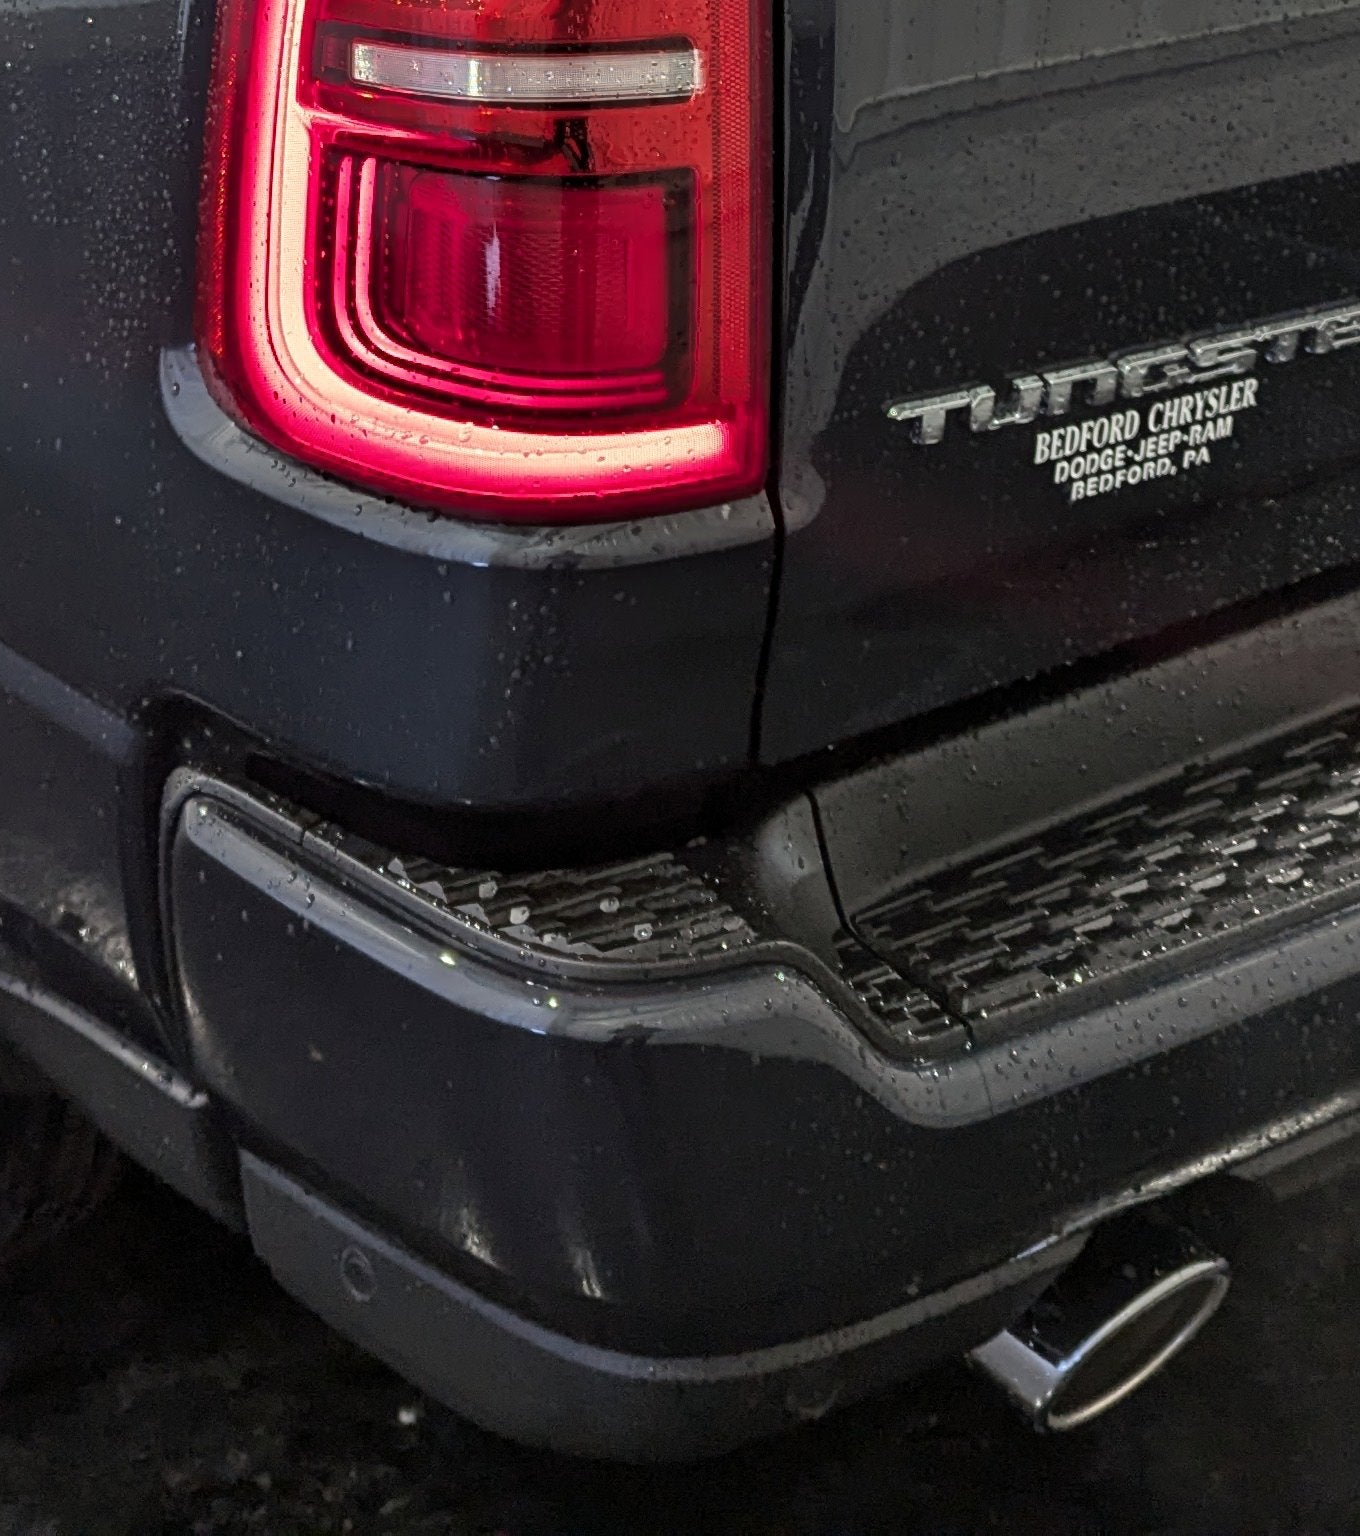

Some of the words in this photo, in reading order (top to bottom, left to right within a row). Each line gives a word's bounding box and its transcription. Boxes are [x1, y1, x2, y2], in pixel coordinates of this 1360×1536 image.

[1034, 408, 1141, 465] BEDFORD
[1148, 377, 1259, 432] CHRYSLER
[1070, 458, 1178, 501] BEDFORD,
[1183, 446, 1212, 469] PA
